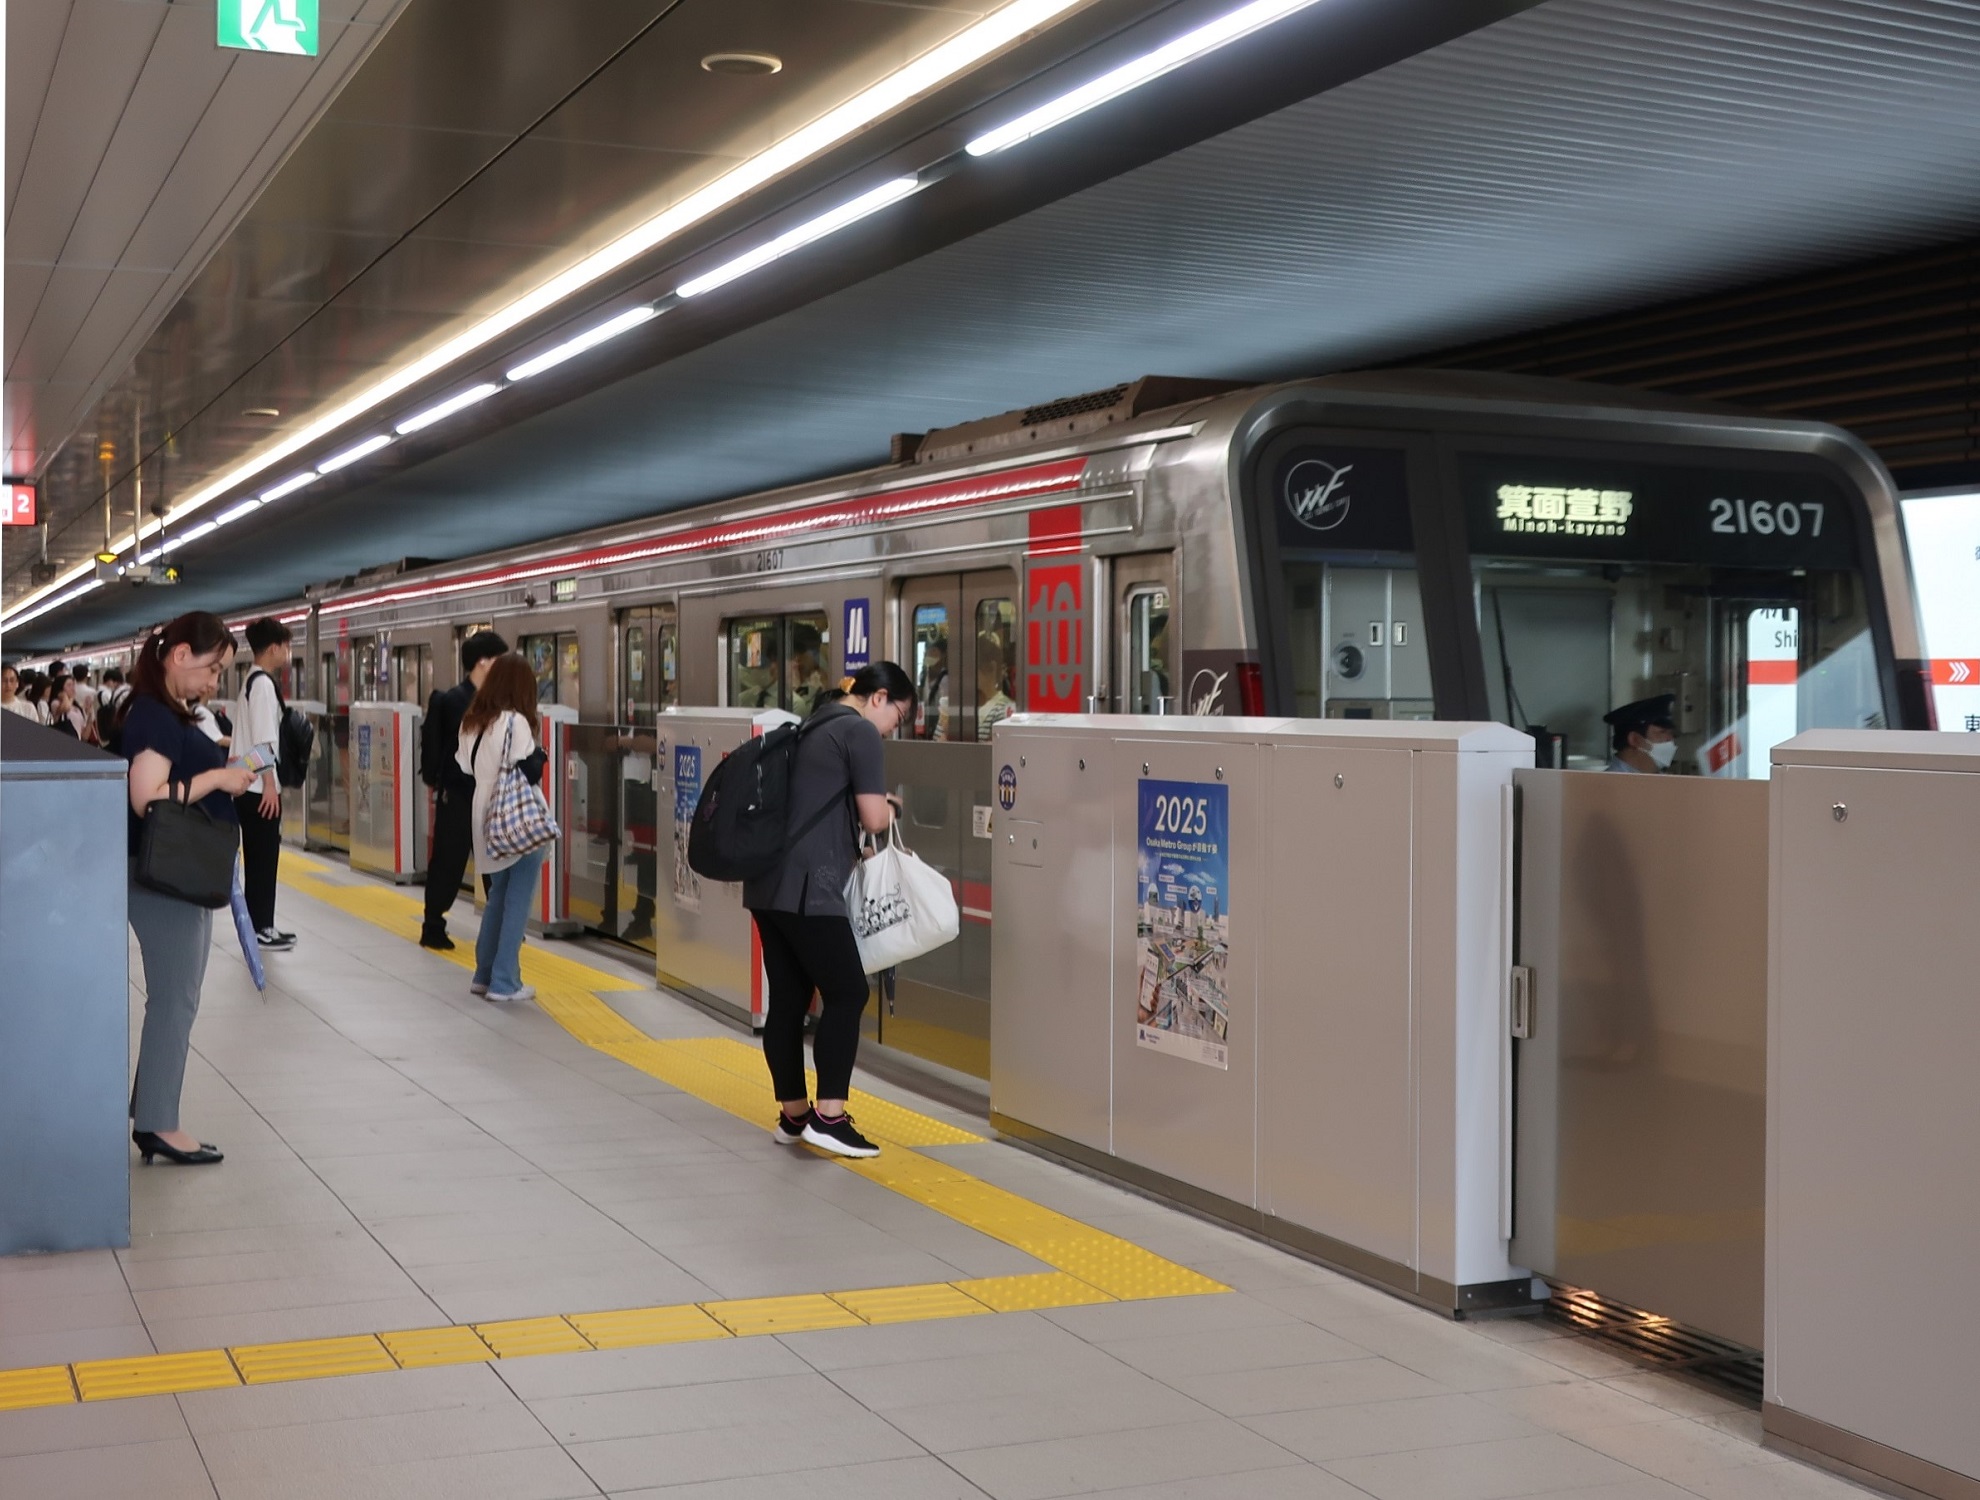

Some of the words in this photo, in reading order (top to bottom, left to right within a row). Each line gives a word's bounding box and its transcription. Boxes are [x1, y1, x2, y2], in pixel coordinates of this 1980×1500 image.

[17, 493, 30, 513] 2
[1497, 484, 1632, 524] 箕面萱野
[1503, 518, 1626, 536] Minoh-kayano
[1710, 498, 1824, 537] 21607
[757, 549, 784, 571] 21607
[1775, 630, 1797, 648] Shi
[678, 753, 697, 778] 2025
[1154, 794, 1208, 836] 2025
